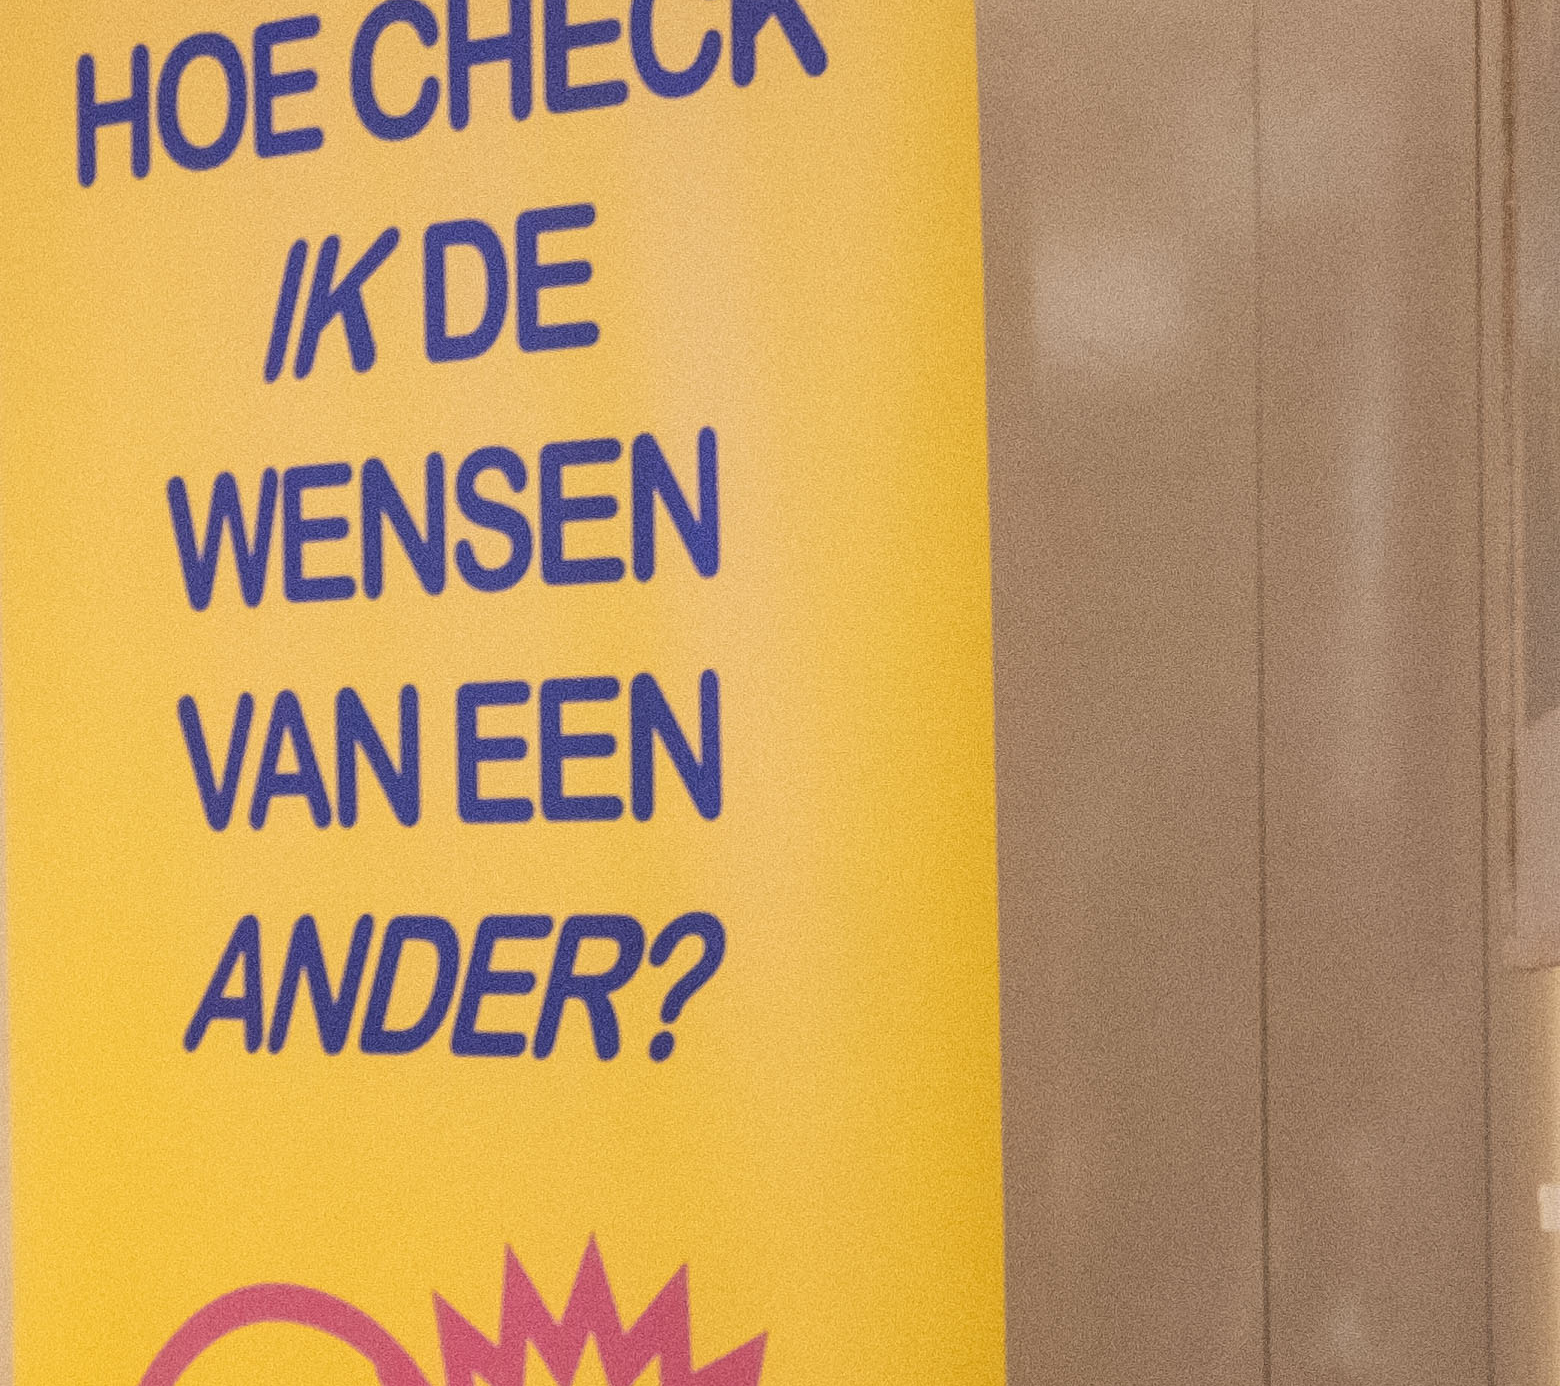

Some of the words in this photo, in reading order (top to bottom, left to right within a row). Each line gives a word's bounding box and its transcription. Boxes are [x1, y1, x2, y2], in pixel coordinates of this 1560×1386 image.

[76, 14, 324, 188] HOE
[264, 226, 401, 383] IK
[423, 203, 600, 363] DE
[166, 426, 720, 612] WENSEN
[177, 684, 421, 832] VAN
[455, 669, 723, 824] EEN
[183, 911, 727, 1063] ANDER?
